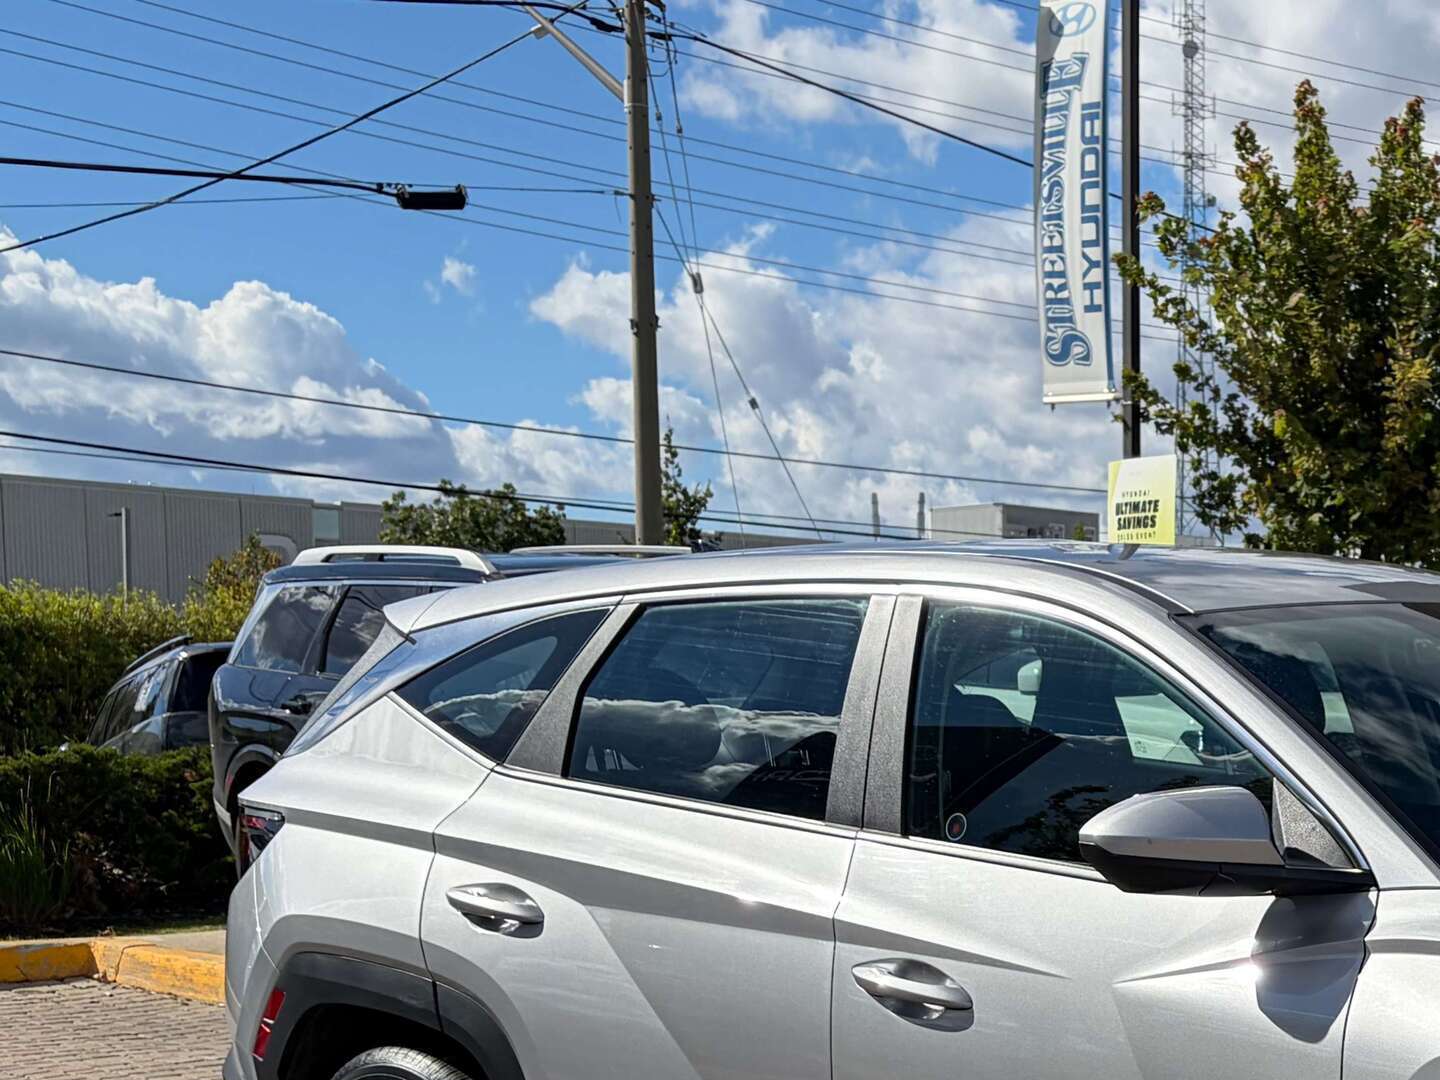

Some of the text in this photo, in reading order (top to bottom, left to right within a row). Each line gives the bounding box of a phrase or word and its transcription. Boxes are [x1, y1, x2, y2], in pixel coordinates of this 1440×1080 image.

[1040, 52, 1092, 366] STREETSVILLE
[1080, 101, 1103, 314] HYUNDAI
[1115, 499, 1160, 516] ULTIMATE
[1117, 515, 1157, 531] SAVINGS
